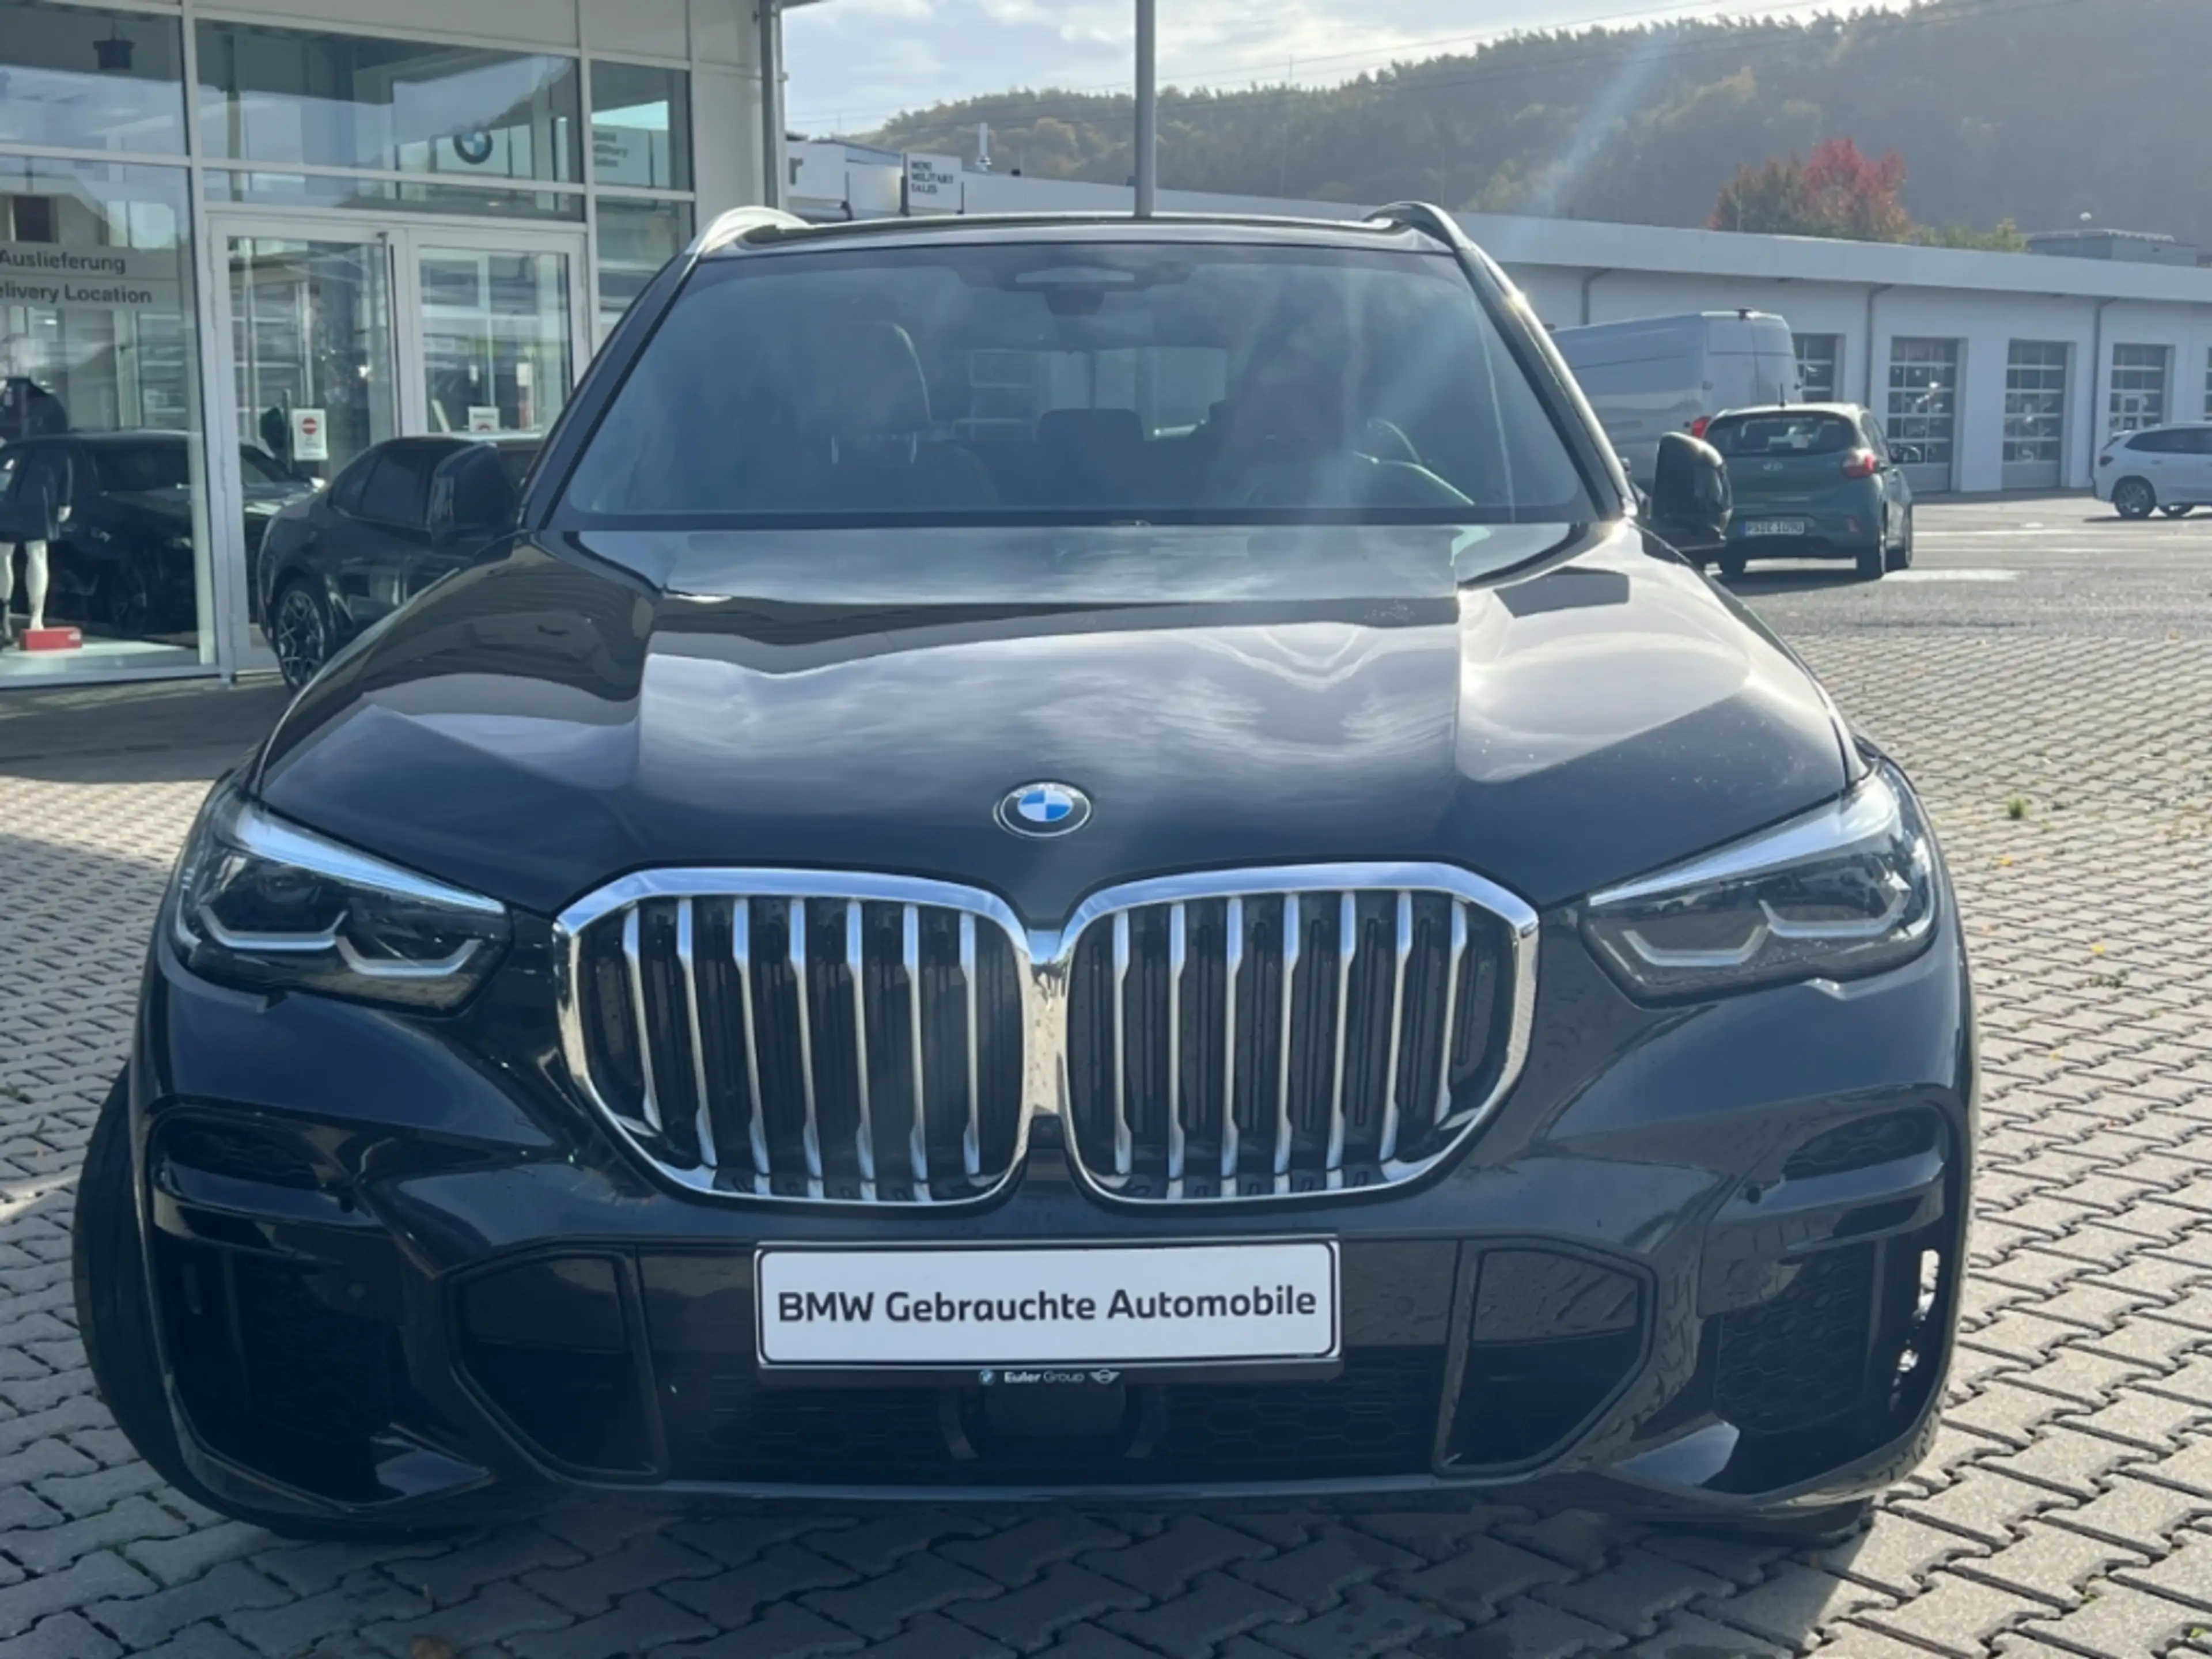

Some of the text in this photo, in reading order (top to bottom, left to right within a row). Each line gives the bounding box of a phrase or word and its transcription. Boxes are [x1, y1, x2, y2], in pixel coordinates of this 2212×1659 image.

[0, 248, 126, 275] Auslieferung
[65, 283, 152, 304] Location
[778, 1284, 1317, 1322] BMW Gebrauchte Automobile
[1004, 1371, 1086, 1384] Euler Group
